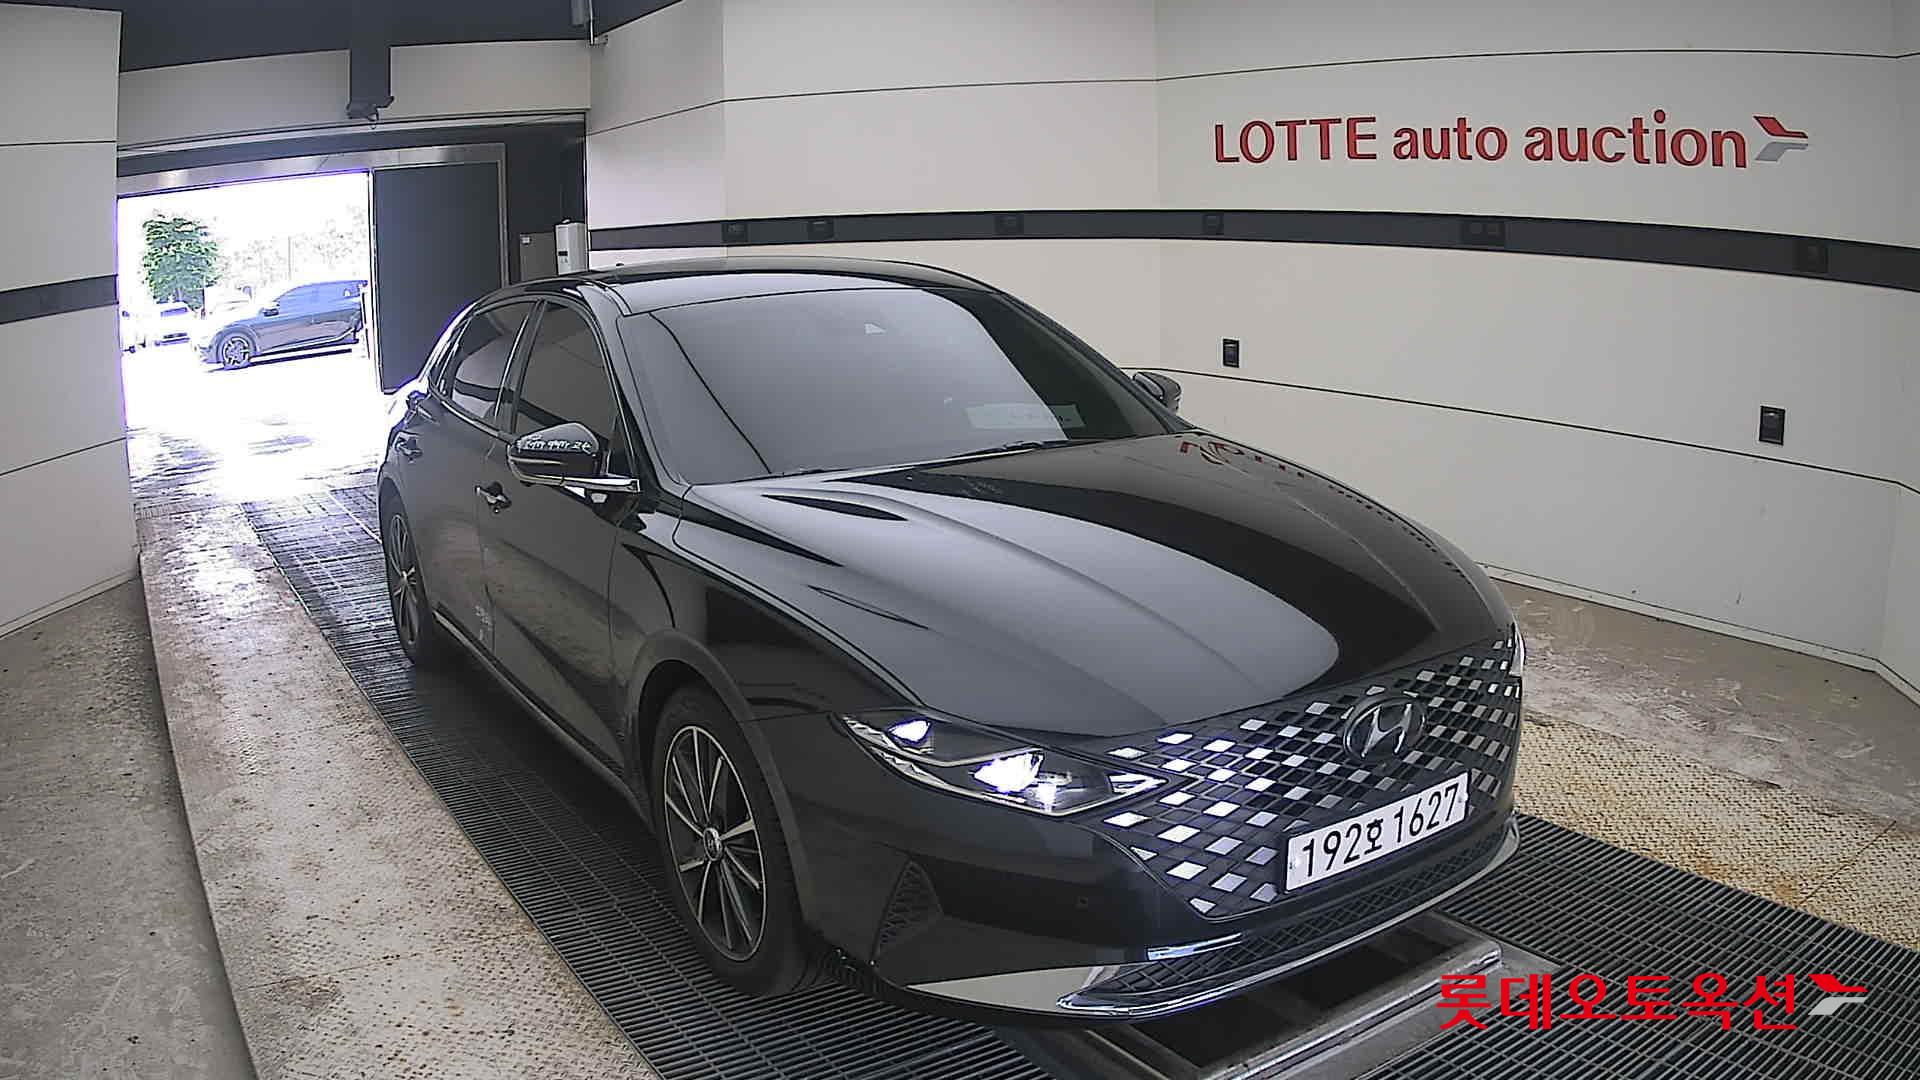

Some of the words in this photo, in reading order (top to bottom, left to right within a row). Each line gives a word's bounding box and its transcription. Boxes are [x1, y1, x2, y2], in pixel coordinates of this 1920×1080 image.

[1214, 117, 1377, 163] LOTTE
[1393, 117, 1508, 162] auto
[1524, 110, 1748, 168] auction
[1303, 818, 1384, 877] 192호
[1393, 783, 1459, 843] 1627
